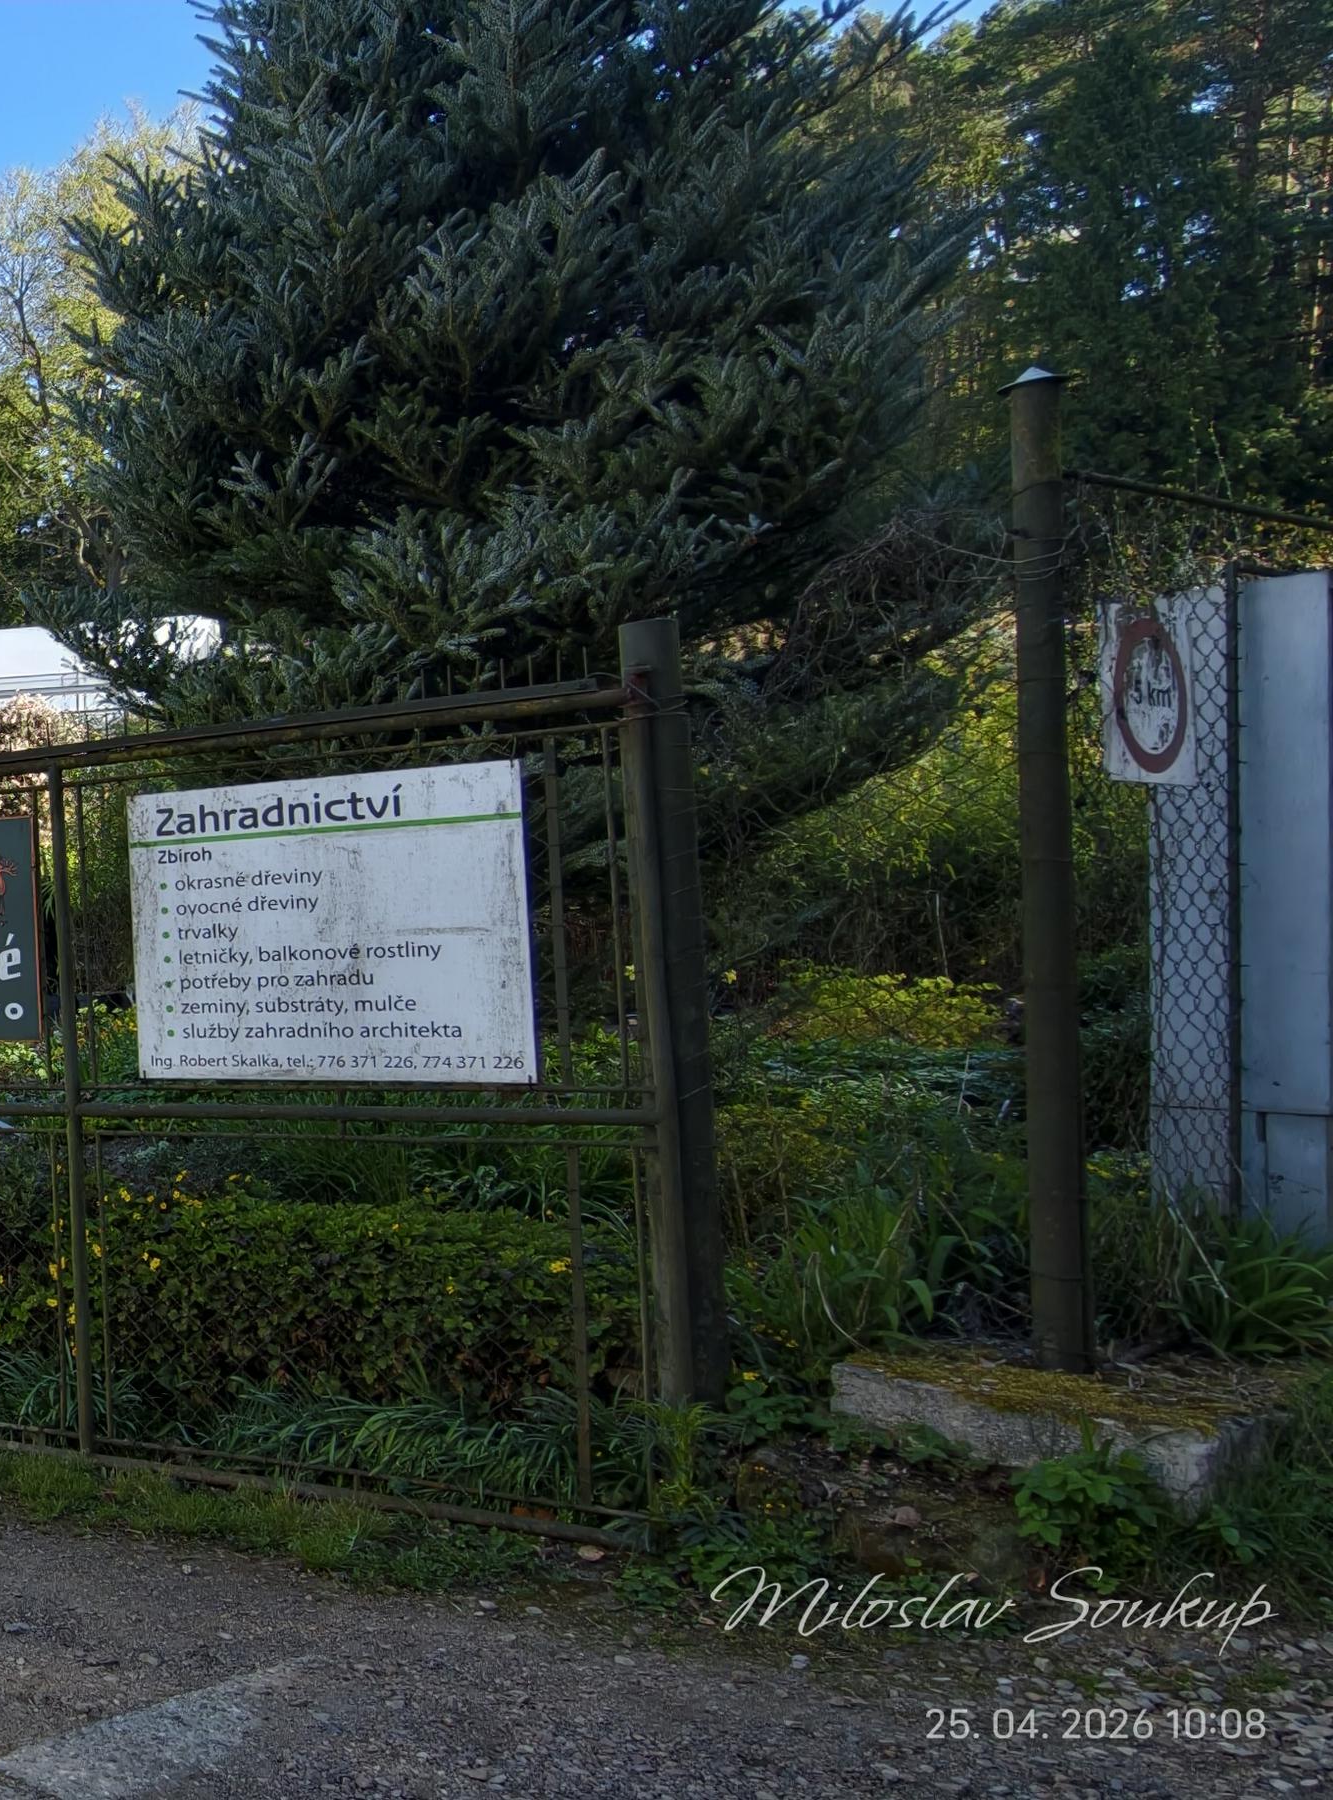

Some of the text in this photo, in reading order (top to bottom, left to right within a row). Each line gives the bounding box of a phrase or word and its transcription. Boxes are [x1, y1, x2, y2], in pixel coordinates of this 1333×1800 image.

[1147, 681, 1172, 708] km
[156, 783, 402, 837] Zahradnictví
[158, 847, 212, 865] Zbiroh
[175, 868, 323, 892] okrasné dřeviny
[176, 894, 319, 915] ovocné dřeviny
[178, 923, 239, 942] trvalky
[179, 941, 442, 966] letničky, balkonové rostliny
[180, 969, 374, 992] potřeby pro zahradu
[181, 995, 417, 1017] zeminy, substráty, mulče
[182, 1021, 463, 1043] služby zahradního architekta
[151, 1055, 176, 1070] Ing.
[180, 1055, 227, 1068] Robert
[232, 1055, 283, 1070] Skalka,
[318, 1056, 346, 1068] 776
[350, 1056, 377, 1068] 371
[384, 1056, 418, 1070] 226,
[422, 1056, 452, 1068] 774
[456, 1056, 486, 1069] 371
[493, 1056, 524, 1069] 226
